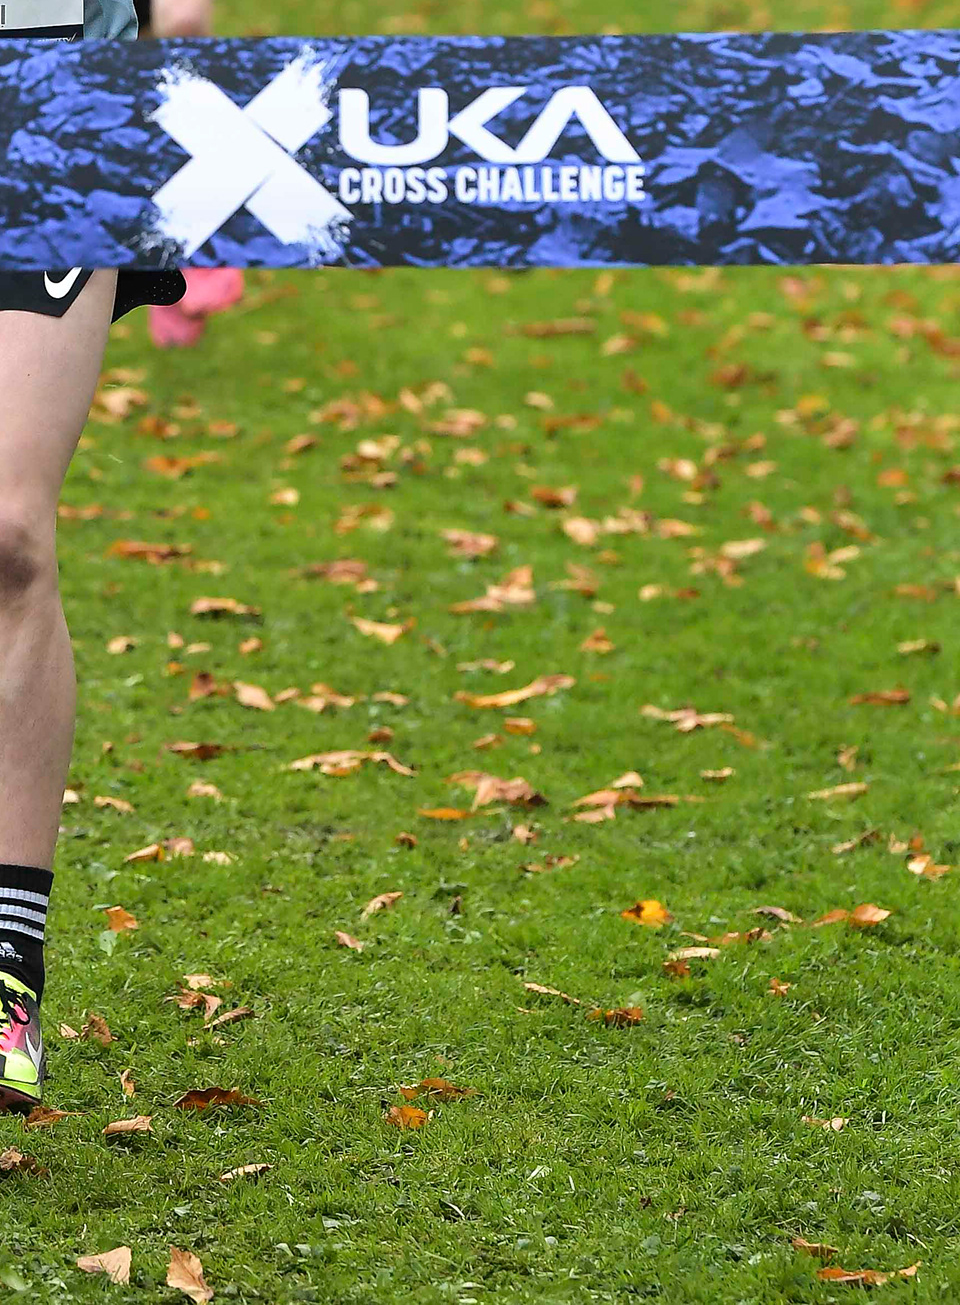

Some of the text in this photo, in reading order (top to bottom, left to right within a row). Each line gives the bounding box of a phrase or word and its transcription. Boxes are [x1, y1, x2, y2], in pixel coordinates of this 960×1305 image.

[340, 85, 642, 166] UKA
[341, 165, 647, 204] CROSS CHALLENGE
